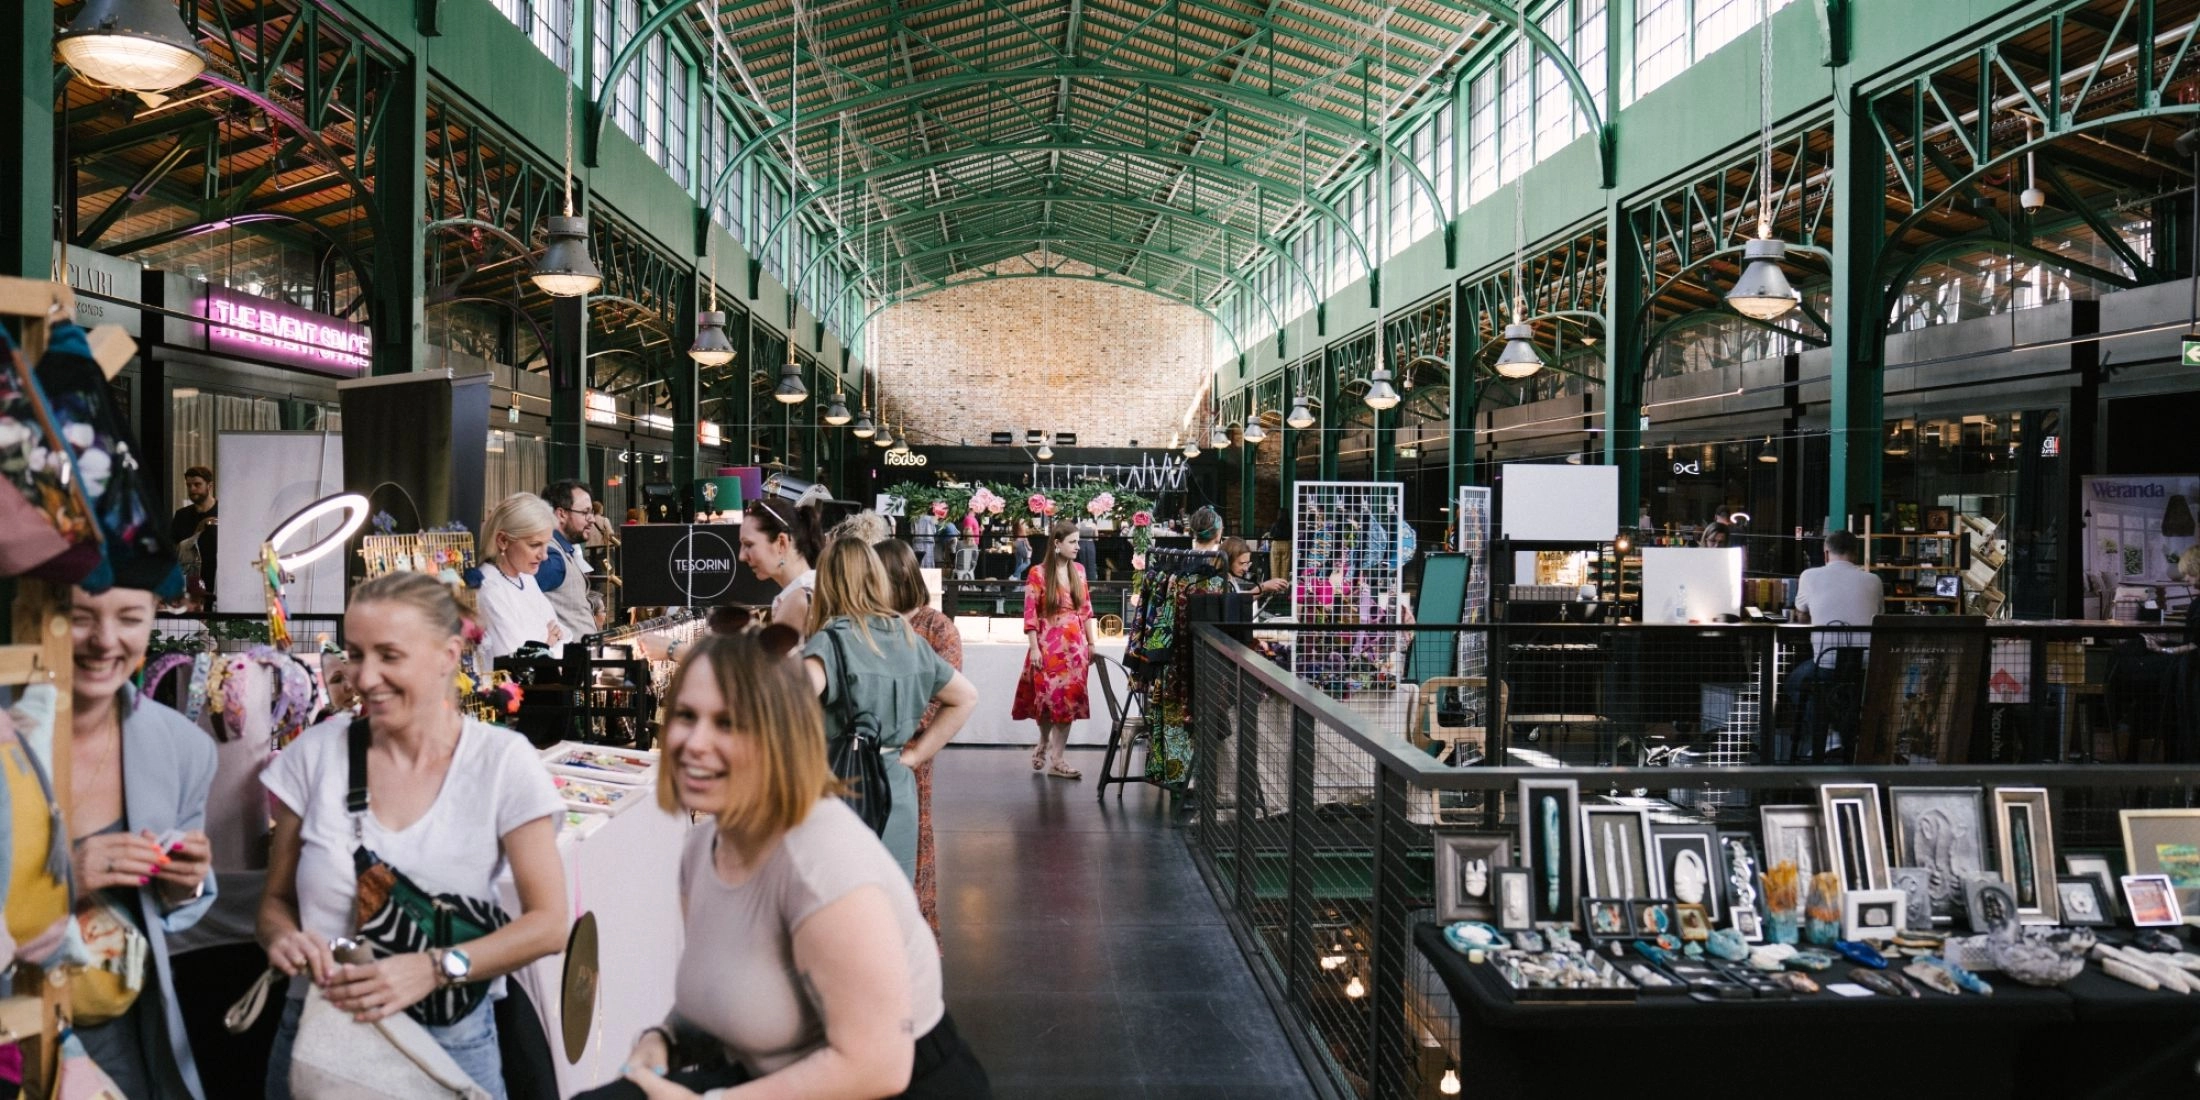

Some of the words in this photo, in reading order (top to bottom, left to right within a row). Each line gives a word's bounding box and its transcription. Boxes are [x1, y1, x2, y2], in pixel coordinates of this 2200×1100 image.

[215, 300, 257, 331] THE
[259, 309, 318, 345] EVENT
[320, 325, 370, 356] SPACE
[2091, 481, 2165, 498] Weranda
[675, 559, 730, 571] TESORINI
